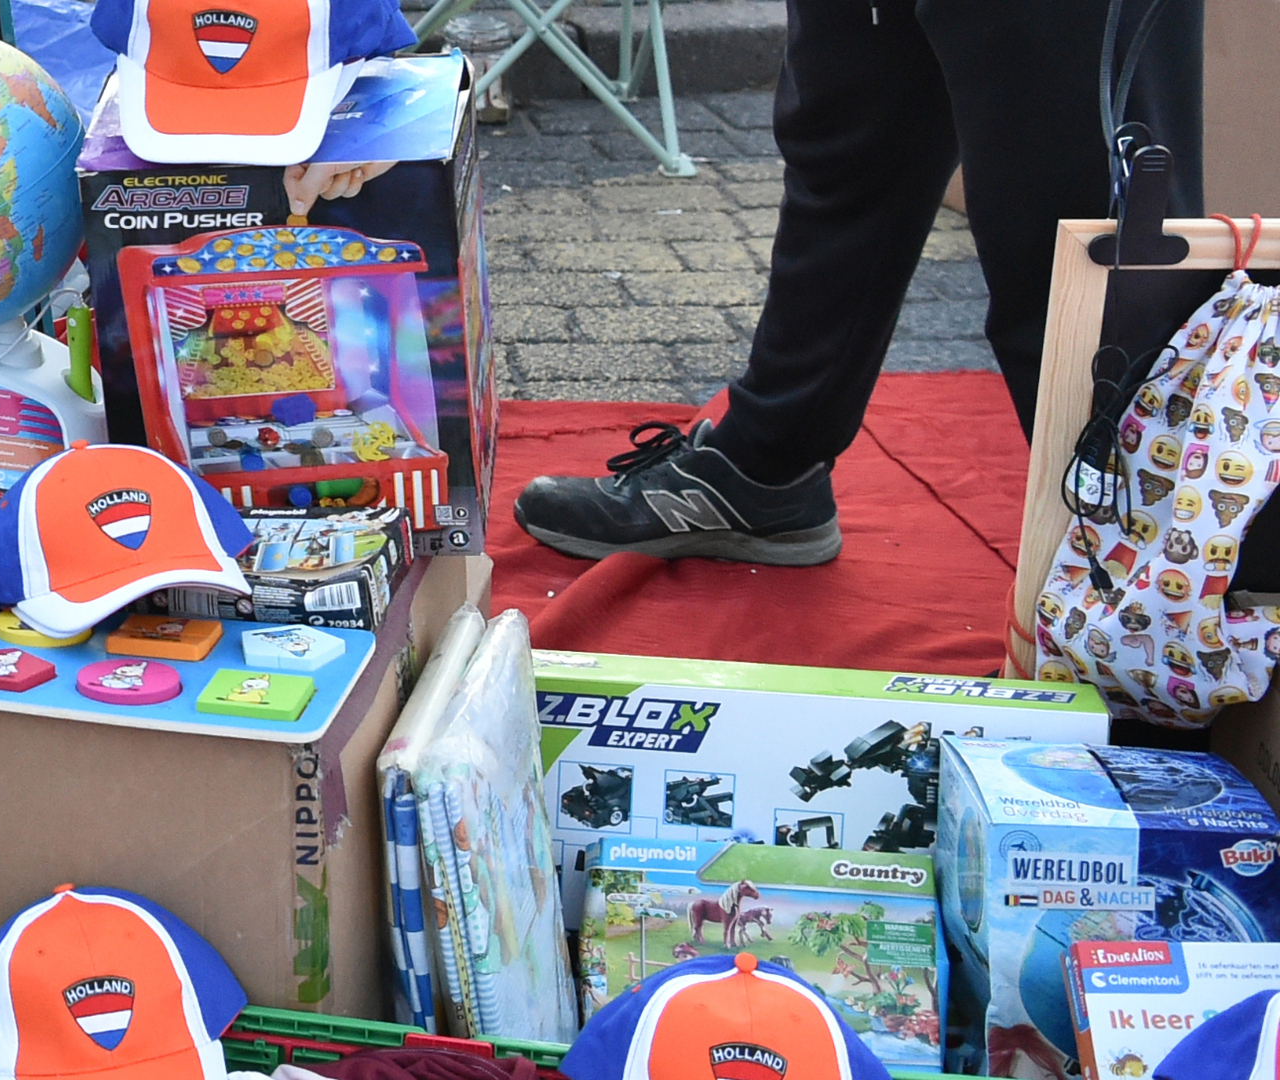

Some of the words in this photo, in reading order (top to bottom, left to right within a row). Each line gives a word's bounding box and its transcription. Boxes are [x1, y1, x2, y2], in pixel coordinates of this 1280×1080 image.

[194, 13, 255, 29] HOLLAND
[123, 174, 228, 187] ELECTRONIC
[91, 184, 250, 212] ARCADE
[104, 212, 158, 230] COIN
[163, 212, 264, 229] PUSHER
[88, 491, 147, 515] HOLLAND
[249, 507, 308, 517] playmobil
[606, 730, 683, 750] EXPERT
[999, 796, 1081, 810] Wereldbol
[1003, 806, 1088, 822] Overdag
[1203, 817, 1269, 830] Nachts
[609, 844, 697, 863] playmobil
[833, 861, 926, 886] Country
[1013, 857, 1129, 886] WERELDBOL
[1043, 889, 1076, 905] DAG
[1080, 887, 1095, 907] &
[1097, 891, 1152, 906] NACHT
[1108, 974, 1181, 987] Clementoni
[65, 980, 131, 1004] HOLLAND
[1108, 1008, 1135, 1030] Ik
[1140, 1008, 1195, 1031] leer
[712, 1046, 784, 1071] HOLLAND
